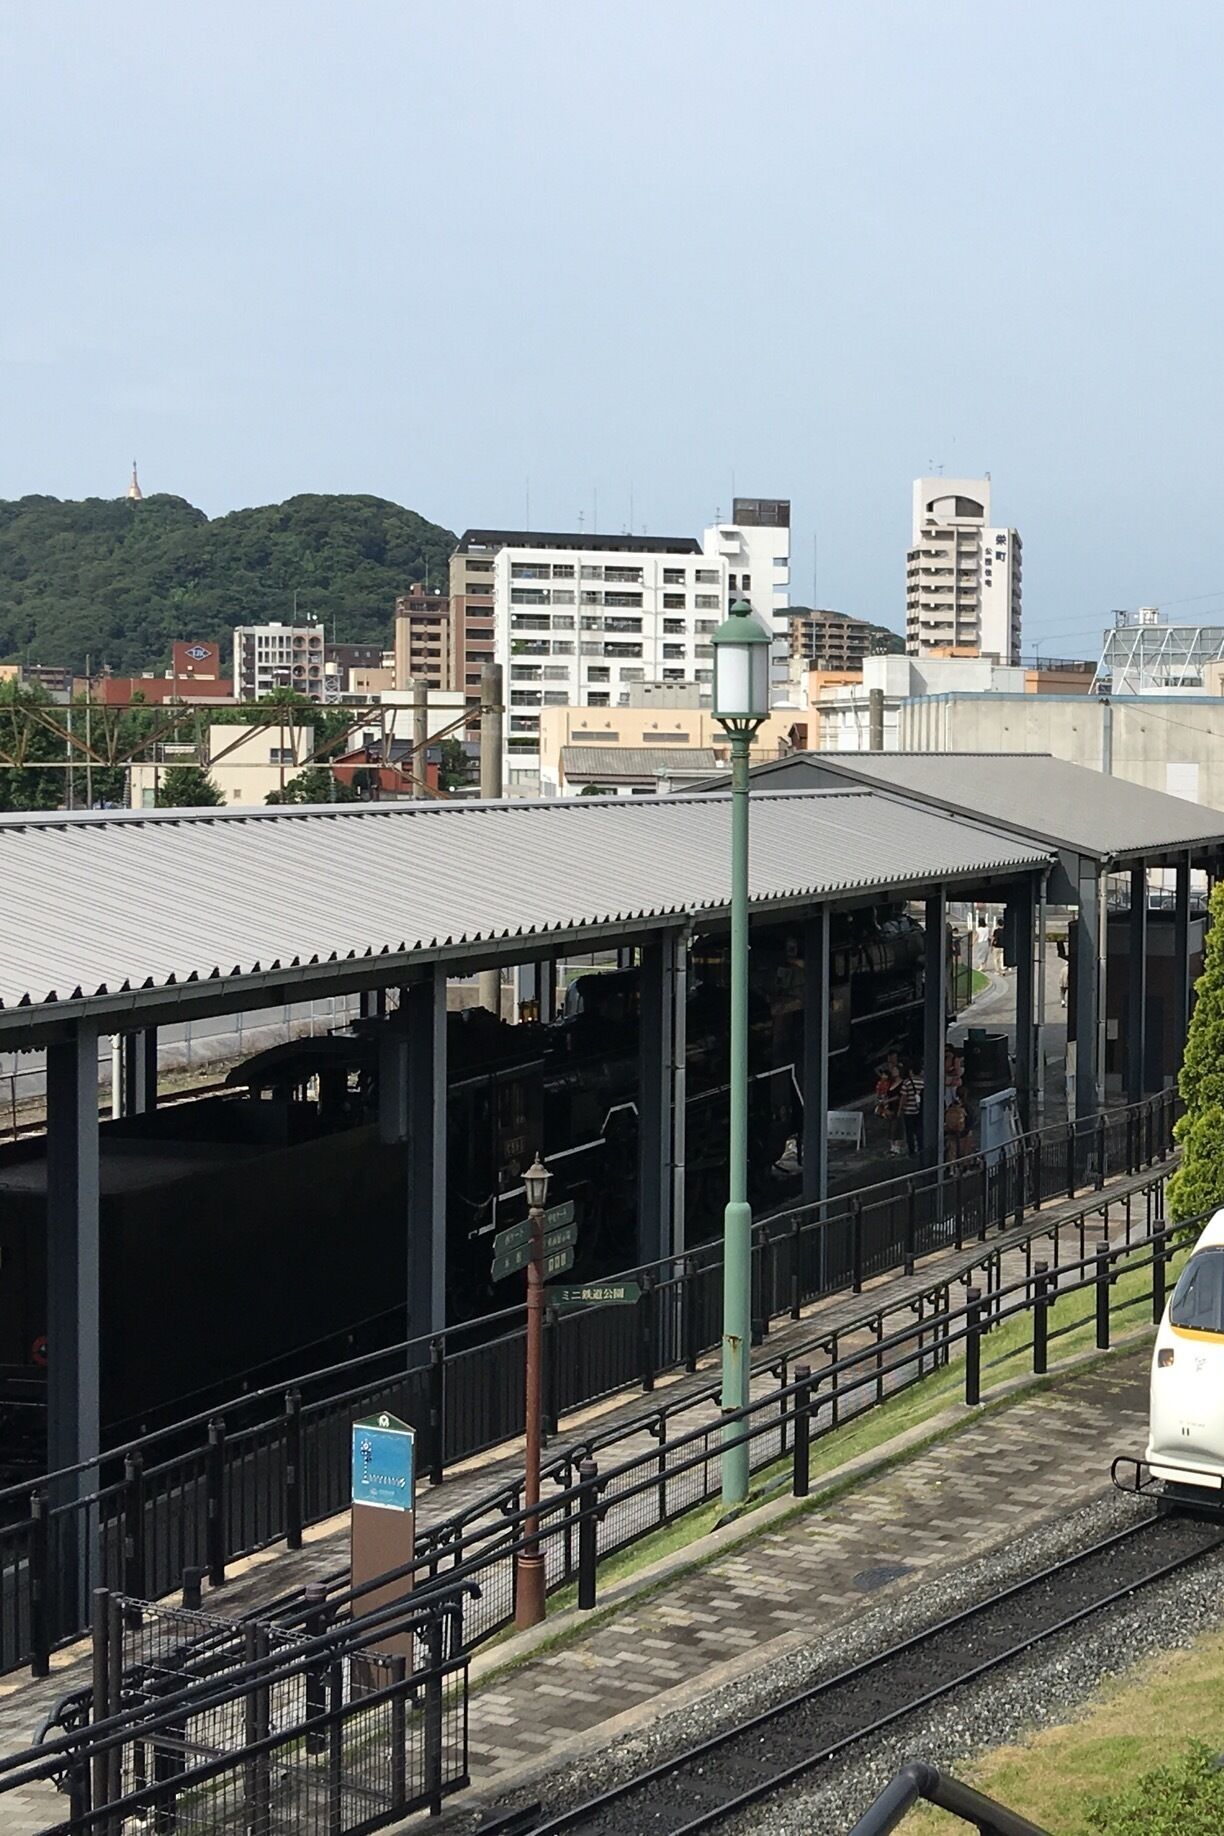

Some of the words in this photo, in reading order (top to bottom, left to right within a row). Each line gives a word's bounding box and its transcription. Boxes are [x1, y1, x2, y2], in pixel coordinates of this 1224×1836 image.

[995, 534, 1007, 562] 栄町
[562, 1288, 625, 1301] ミニ鉄道公園
